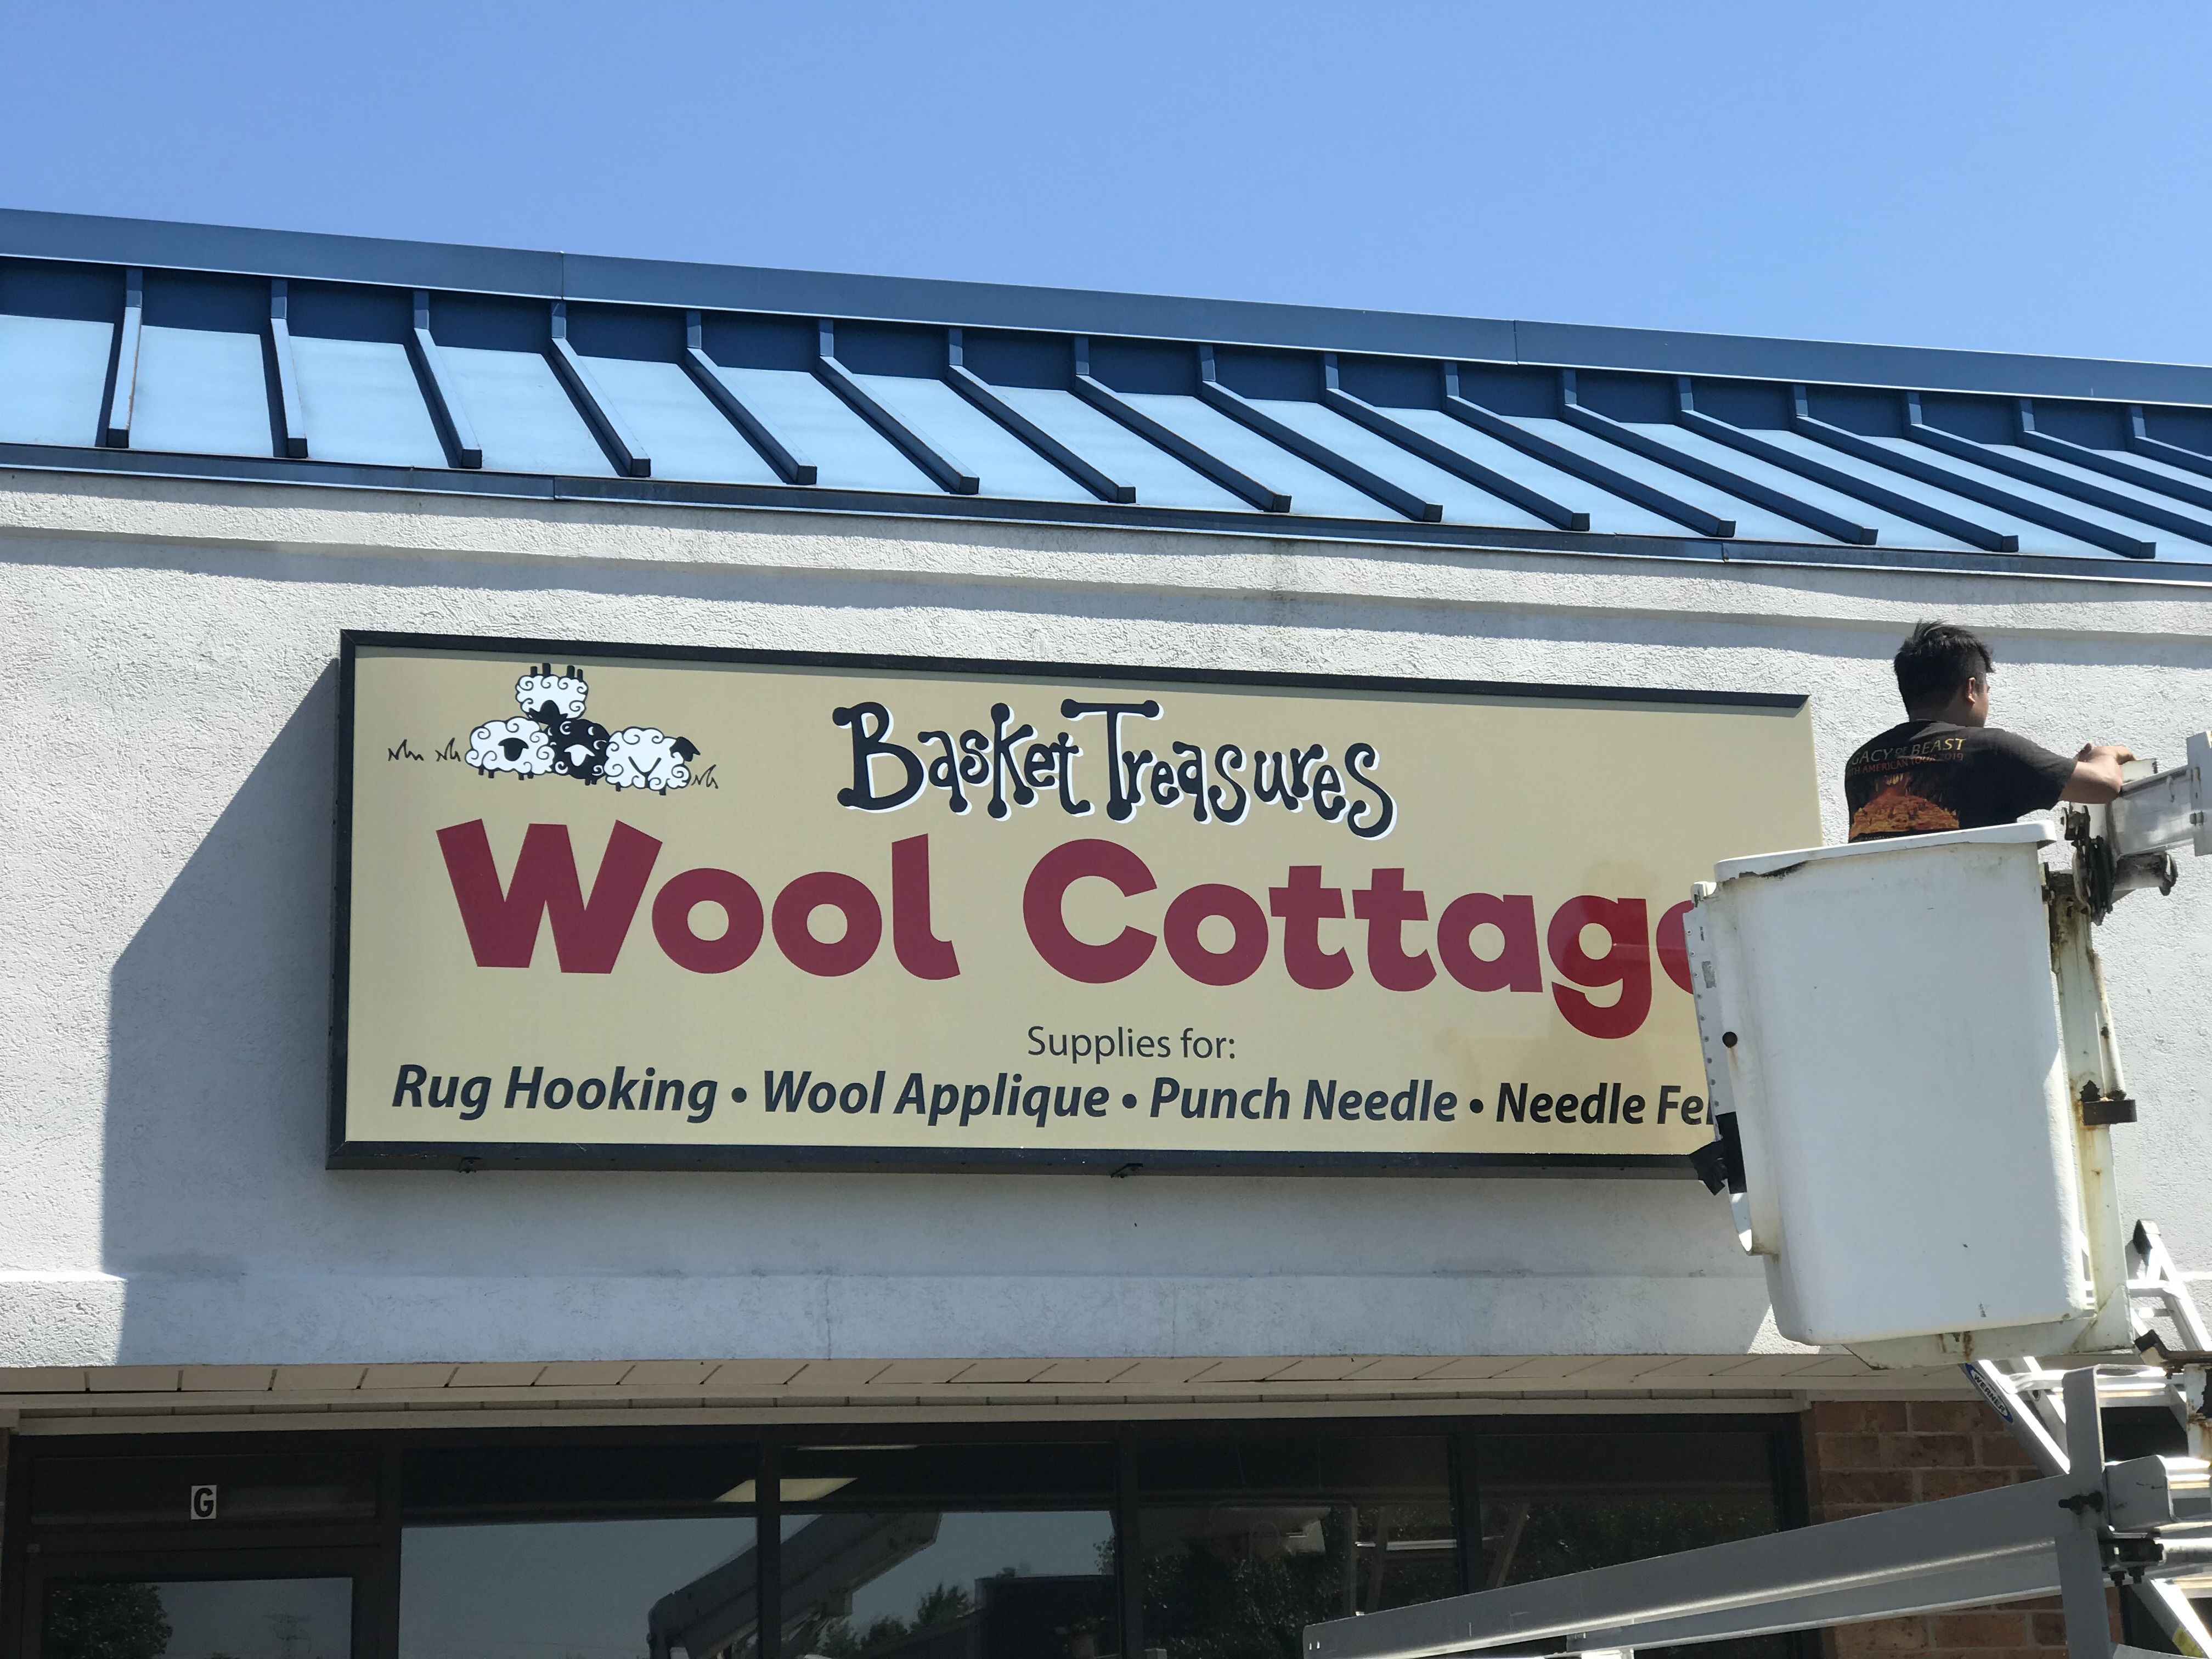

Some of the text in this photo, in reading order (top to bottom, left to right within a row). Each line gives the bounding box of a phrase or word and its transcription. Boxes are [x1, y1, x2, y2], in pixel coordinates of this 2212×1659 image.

[1863, 758, 1909, 772] AMERICAN
[1911, 737, 1967, 756] BEAST
[832, 697, 1396, 839] Basket Treasures
[437, 819, 960, 979] Wool
[1029, 1026, 1235, 1064] Supplies for:
[392, 1064, 492, 1121] Rug
[504, 1066, 717, 1123] Hooking
[765, 1071, 885, 1113] Wool
[893, 1073, 1109, 1127] Applique
[1150, 1077, 1290, 1119] Punch
[1304, 1080, 1457, 1121] Needle
[1497, 1082, 1645, 1124] Needle
[1974, 1374, 2005, 1412] WERNER
[193, 1487, 214, 1517] G
